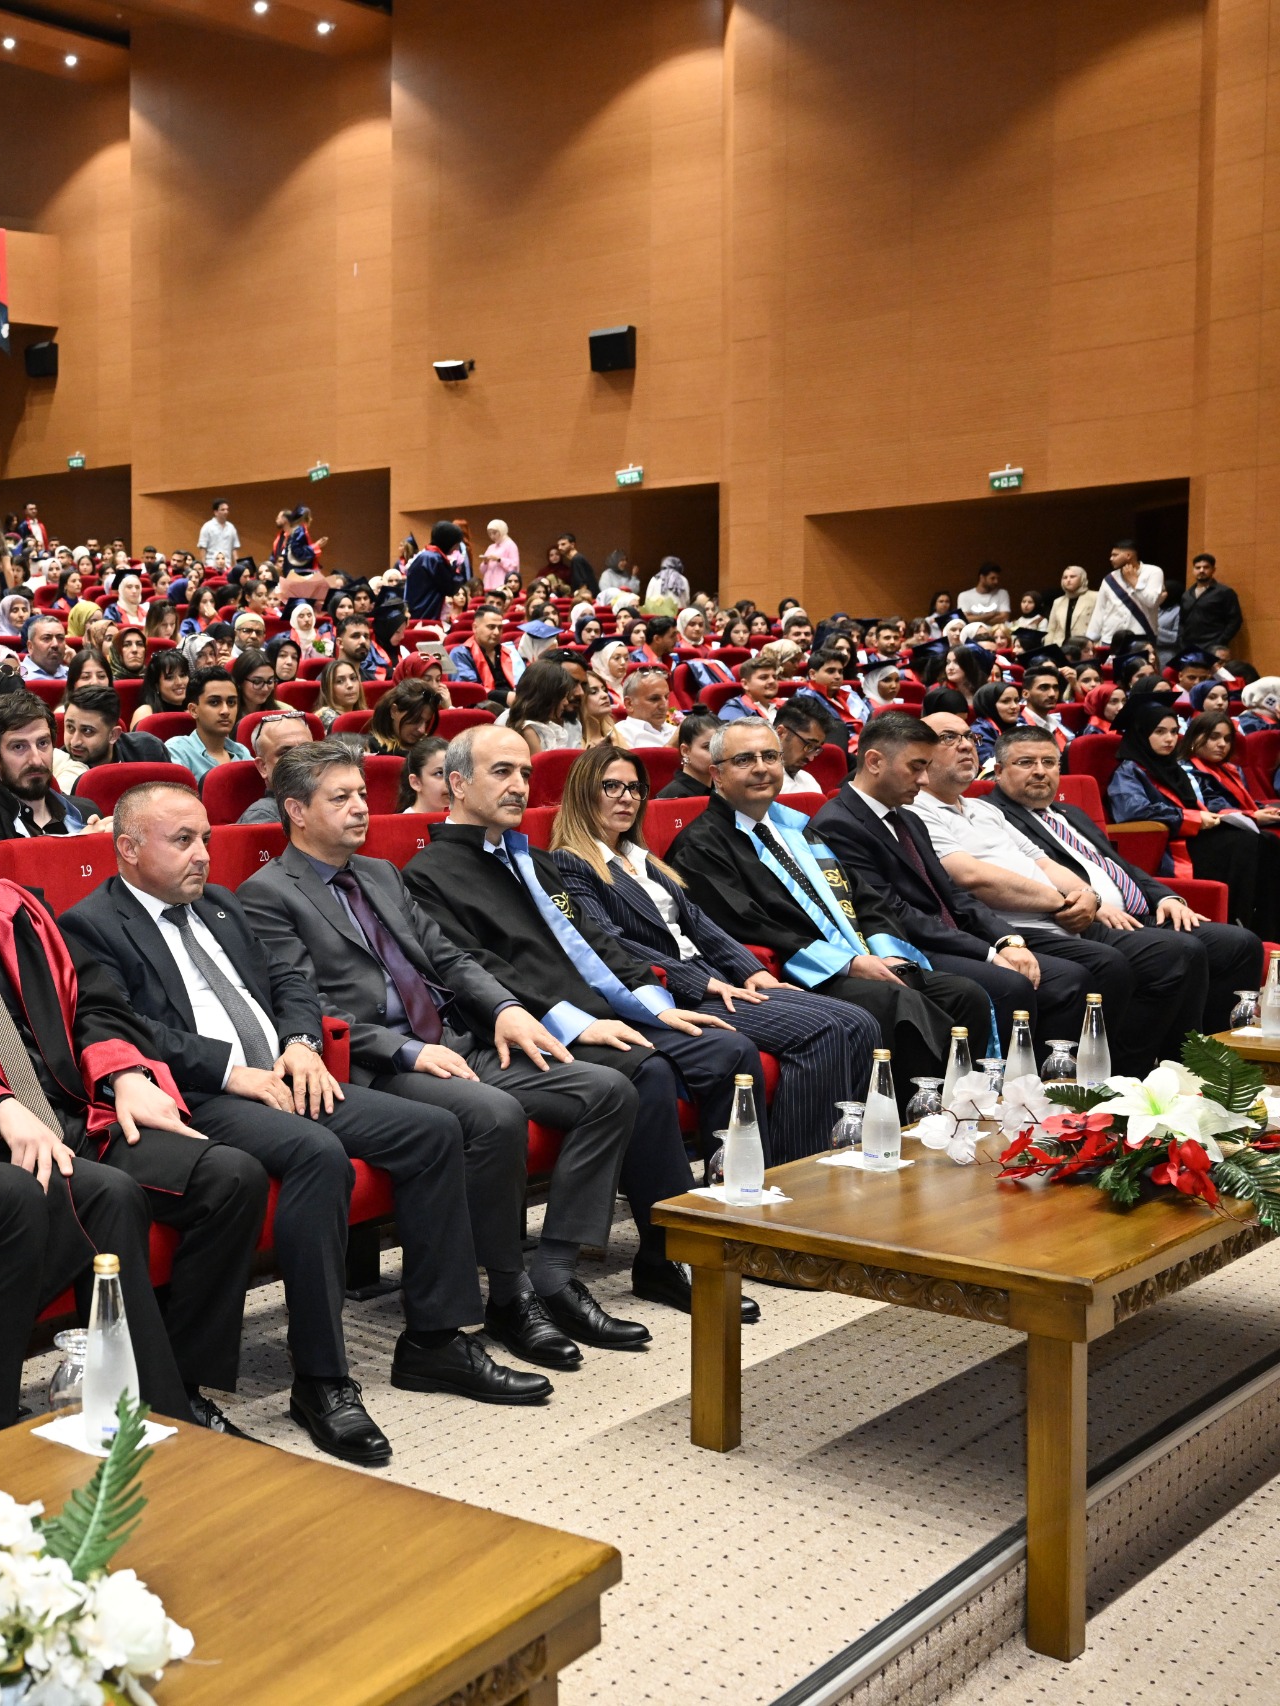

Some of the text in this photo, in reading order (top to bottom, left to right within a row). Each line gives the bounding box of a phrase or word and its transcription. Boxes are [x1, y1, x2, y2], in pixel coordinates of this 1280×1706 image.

[675, 818, 683, 828] 23
[416, 838, 426, 849] 21
[258, 850, 270, 862] 20
[80, 864, 93, 877] 19
